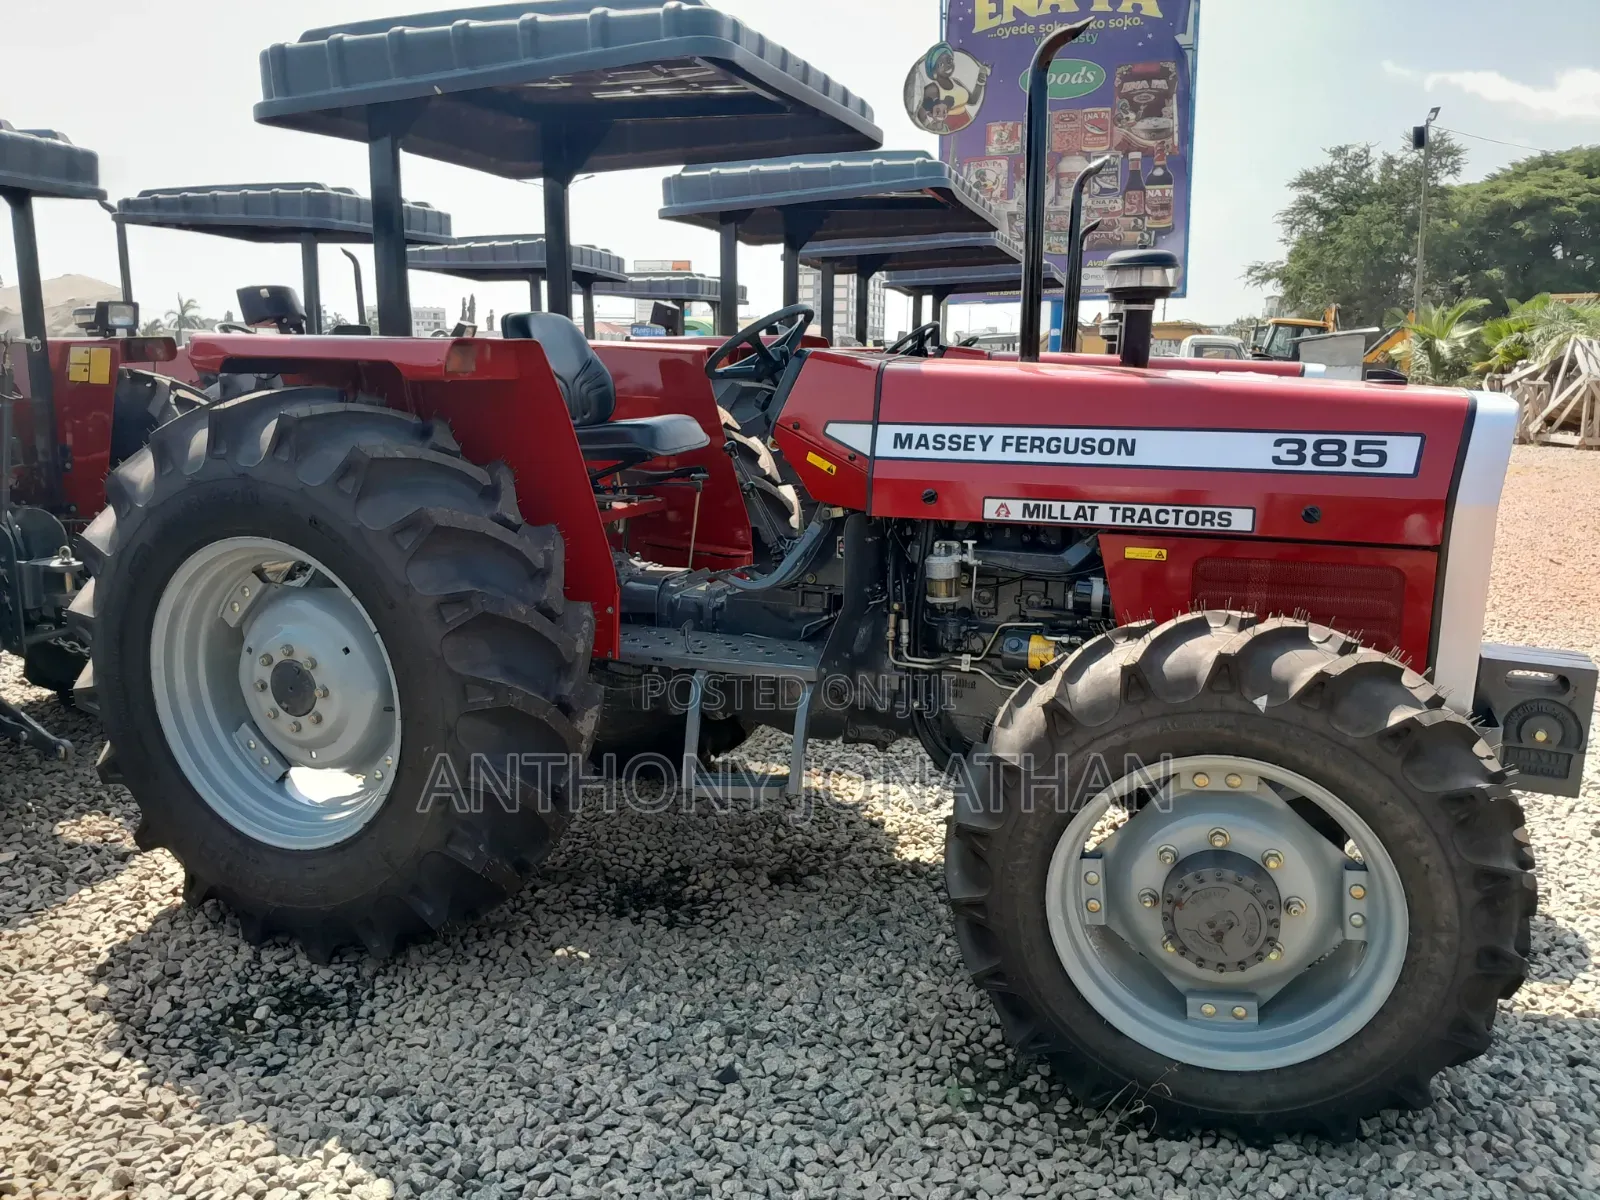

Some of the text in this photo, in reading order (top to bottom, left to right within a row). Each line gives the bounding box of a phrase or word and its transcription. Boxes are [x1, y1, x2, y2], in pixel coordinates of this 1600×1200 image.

[1039, 20, 1069, 33] sok
[1047, 66, 1097, 86] oods
[893, 432, 1136, 457] MASSEY FERGUSON
[1272, 437, 1389, 469] 385
[1022, 503, 1232, 529] MILLAT TRACTORS
